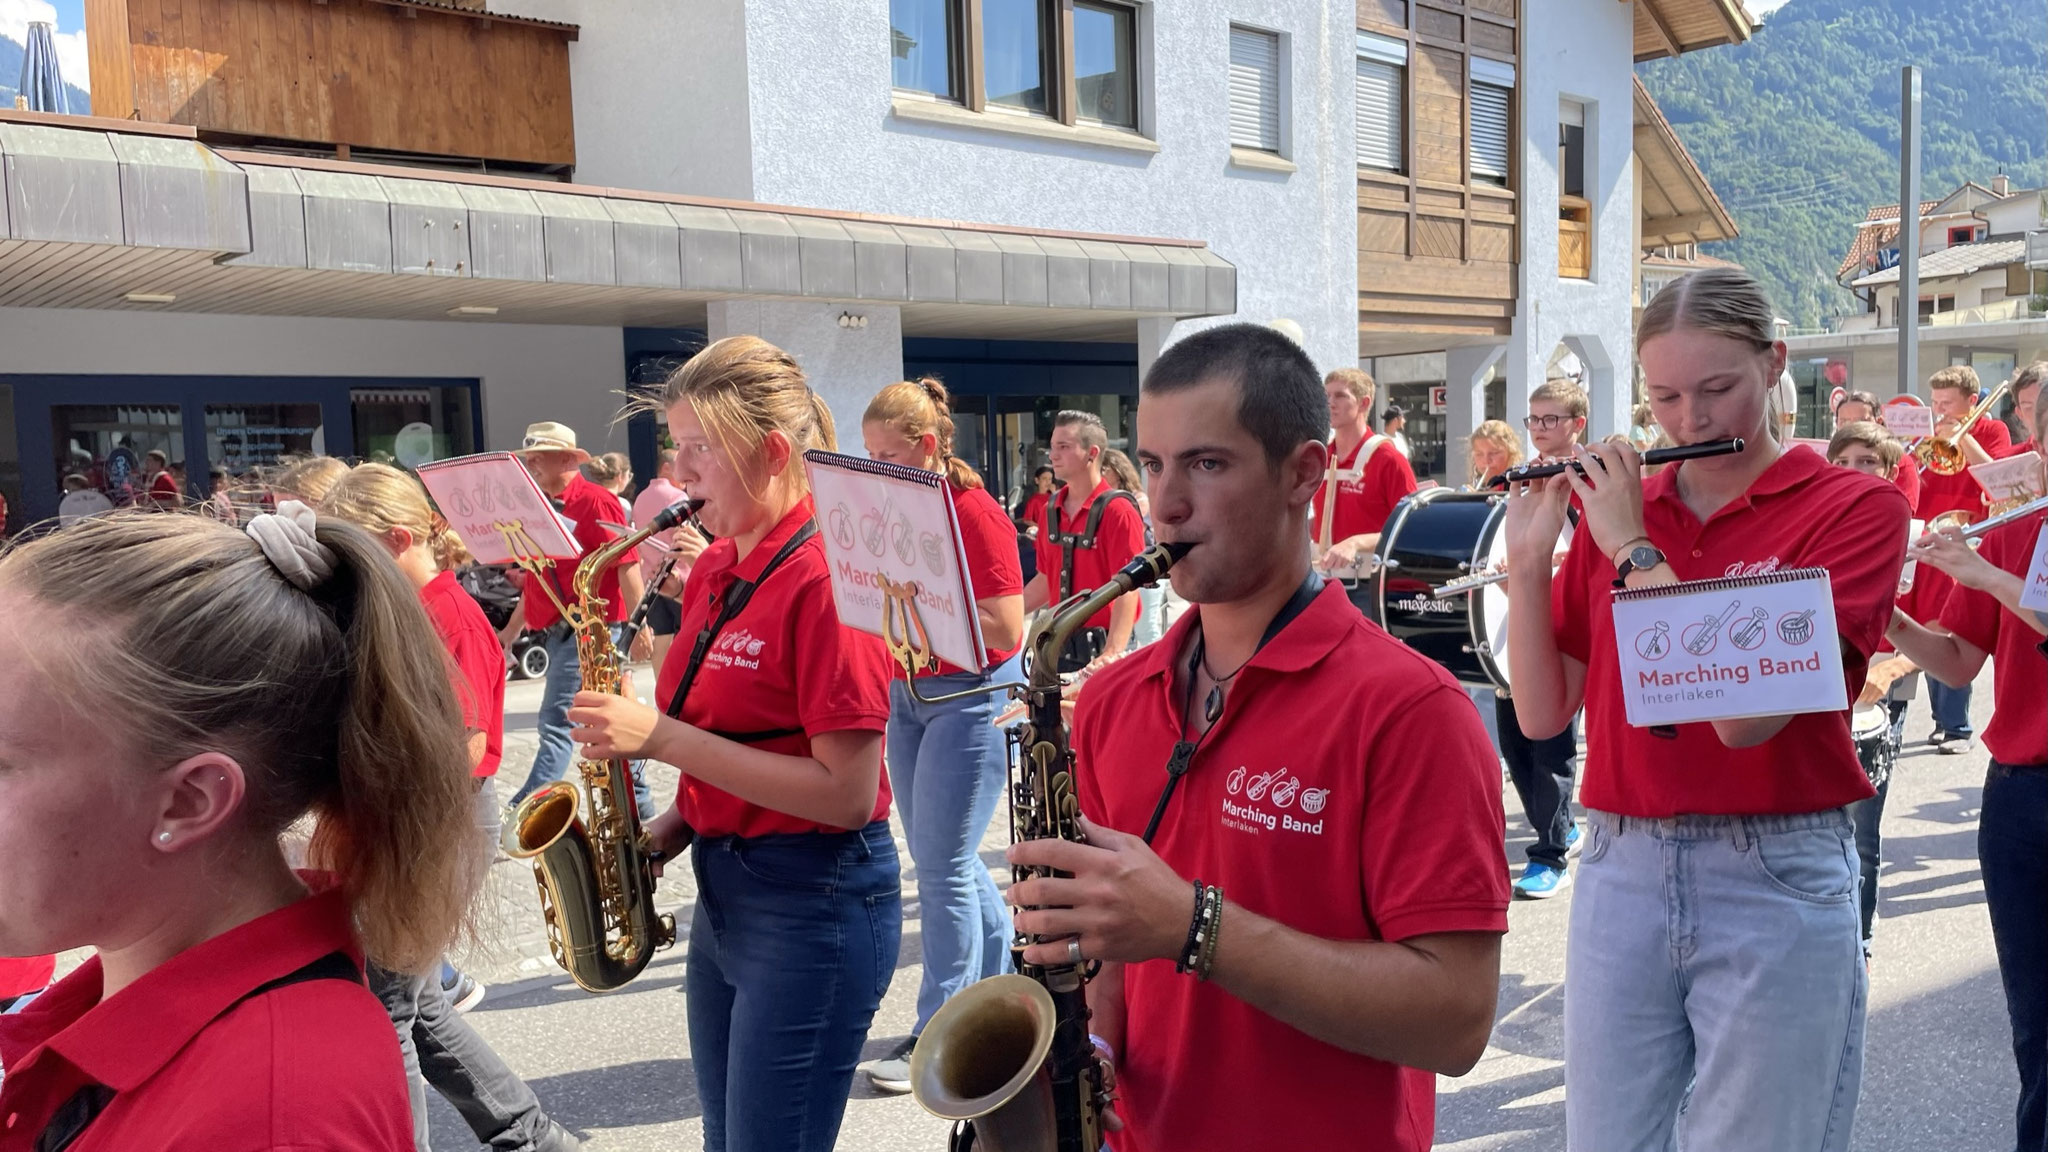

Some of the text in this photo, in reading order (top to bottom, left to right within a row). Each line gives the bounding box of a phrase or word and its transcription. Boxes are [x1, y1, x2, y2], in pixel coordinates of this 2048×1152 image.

[843, 588, 882, 611] Interla
[917, 581, 955, 616] Band
[1398, 593, 1454, 615] majestic
[734, 655, 760, 670] Band
[1638, 651, 1821, 688] Marching Band
[1642, 687, 1725, 705] Interlaken
[1221, 815, 1259, 835] Interlaken
[1222, 798, 1323, 835] Marching Band
